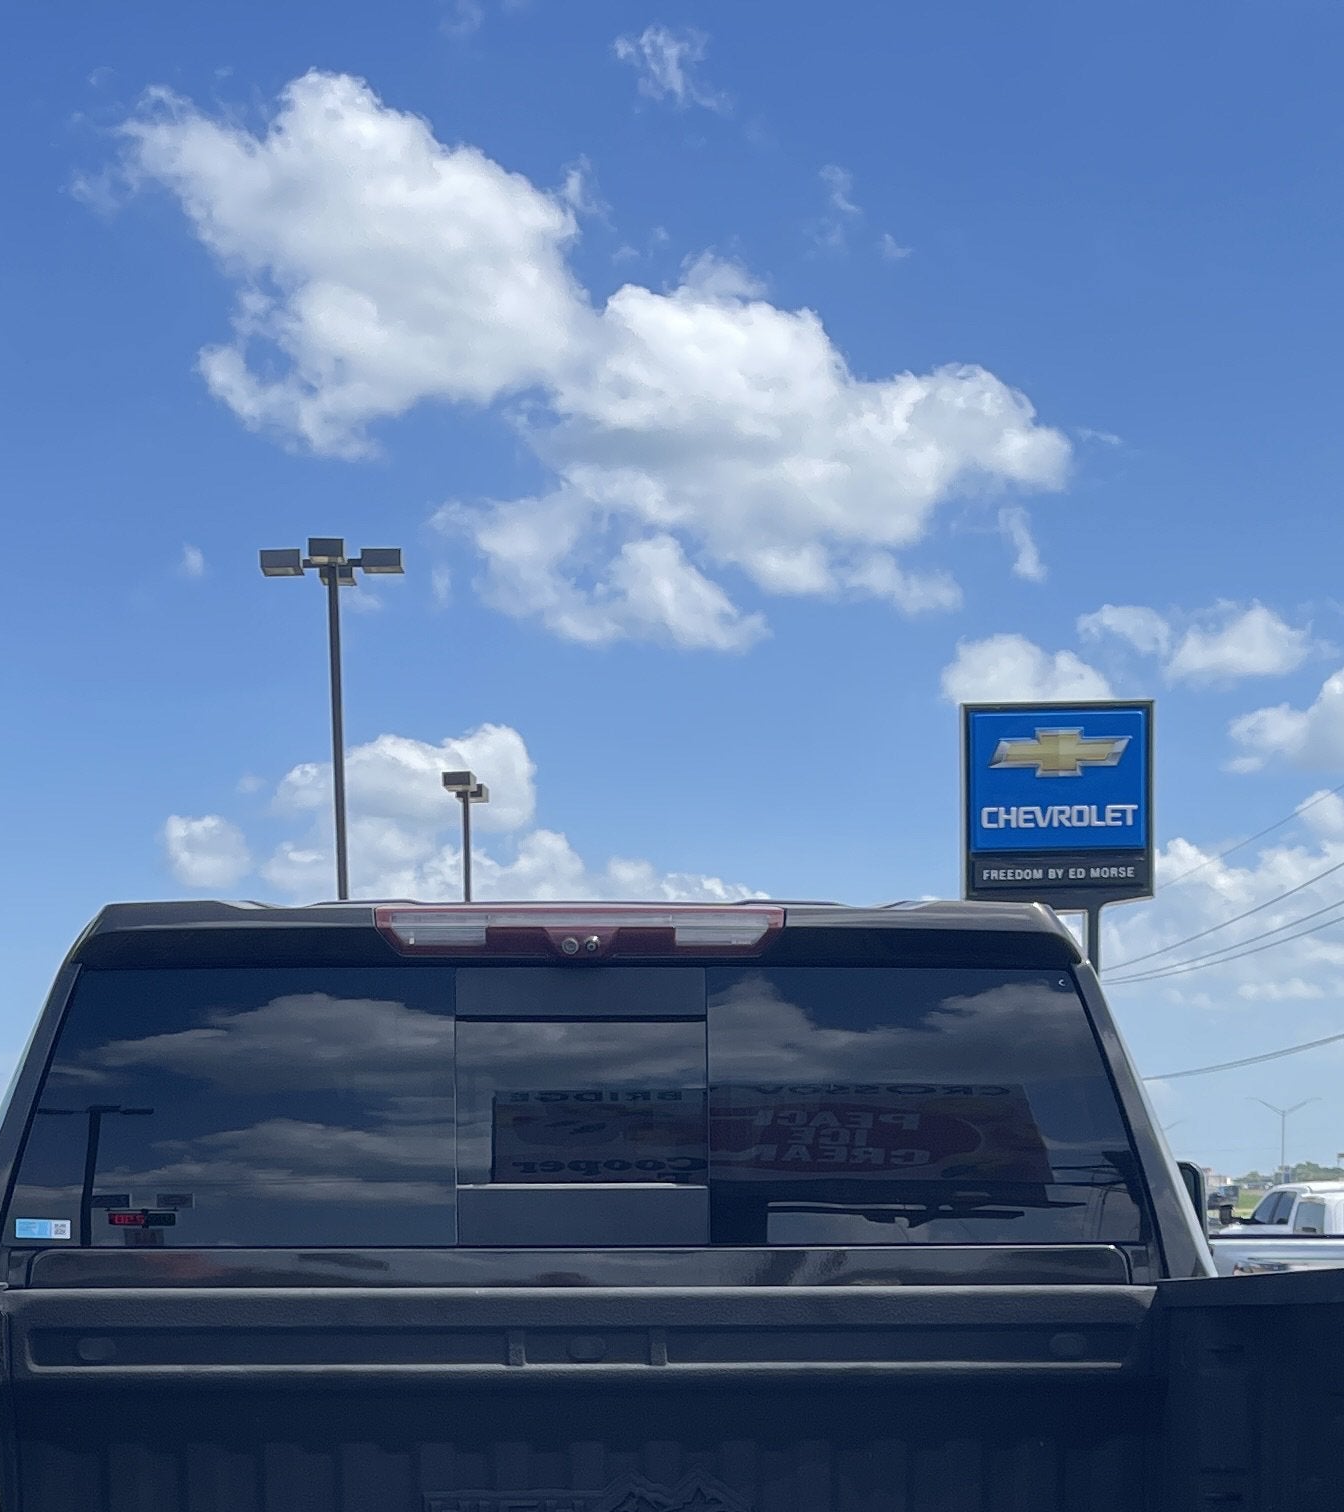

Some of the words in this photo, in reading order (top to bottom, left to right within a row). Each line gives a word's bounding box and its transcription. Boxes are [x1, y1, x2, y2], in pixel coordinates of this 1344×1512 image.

[980, 804, 1138, 829] CHEVROLET
[982, 868, 1043, 880] FREEDOM
[1048, 868, 1064, 879] BY
[1069, 867, 1086, 879] ED
[1090, 866, 1135, 878] MORSE
